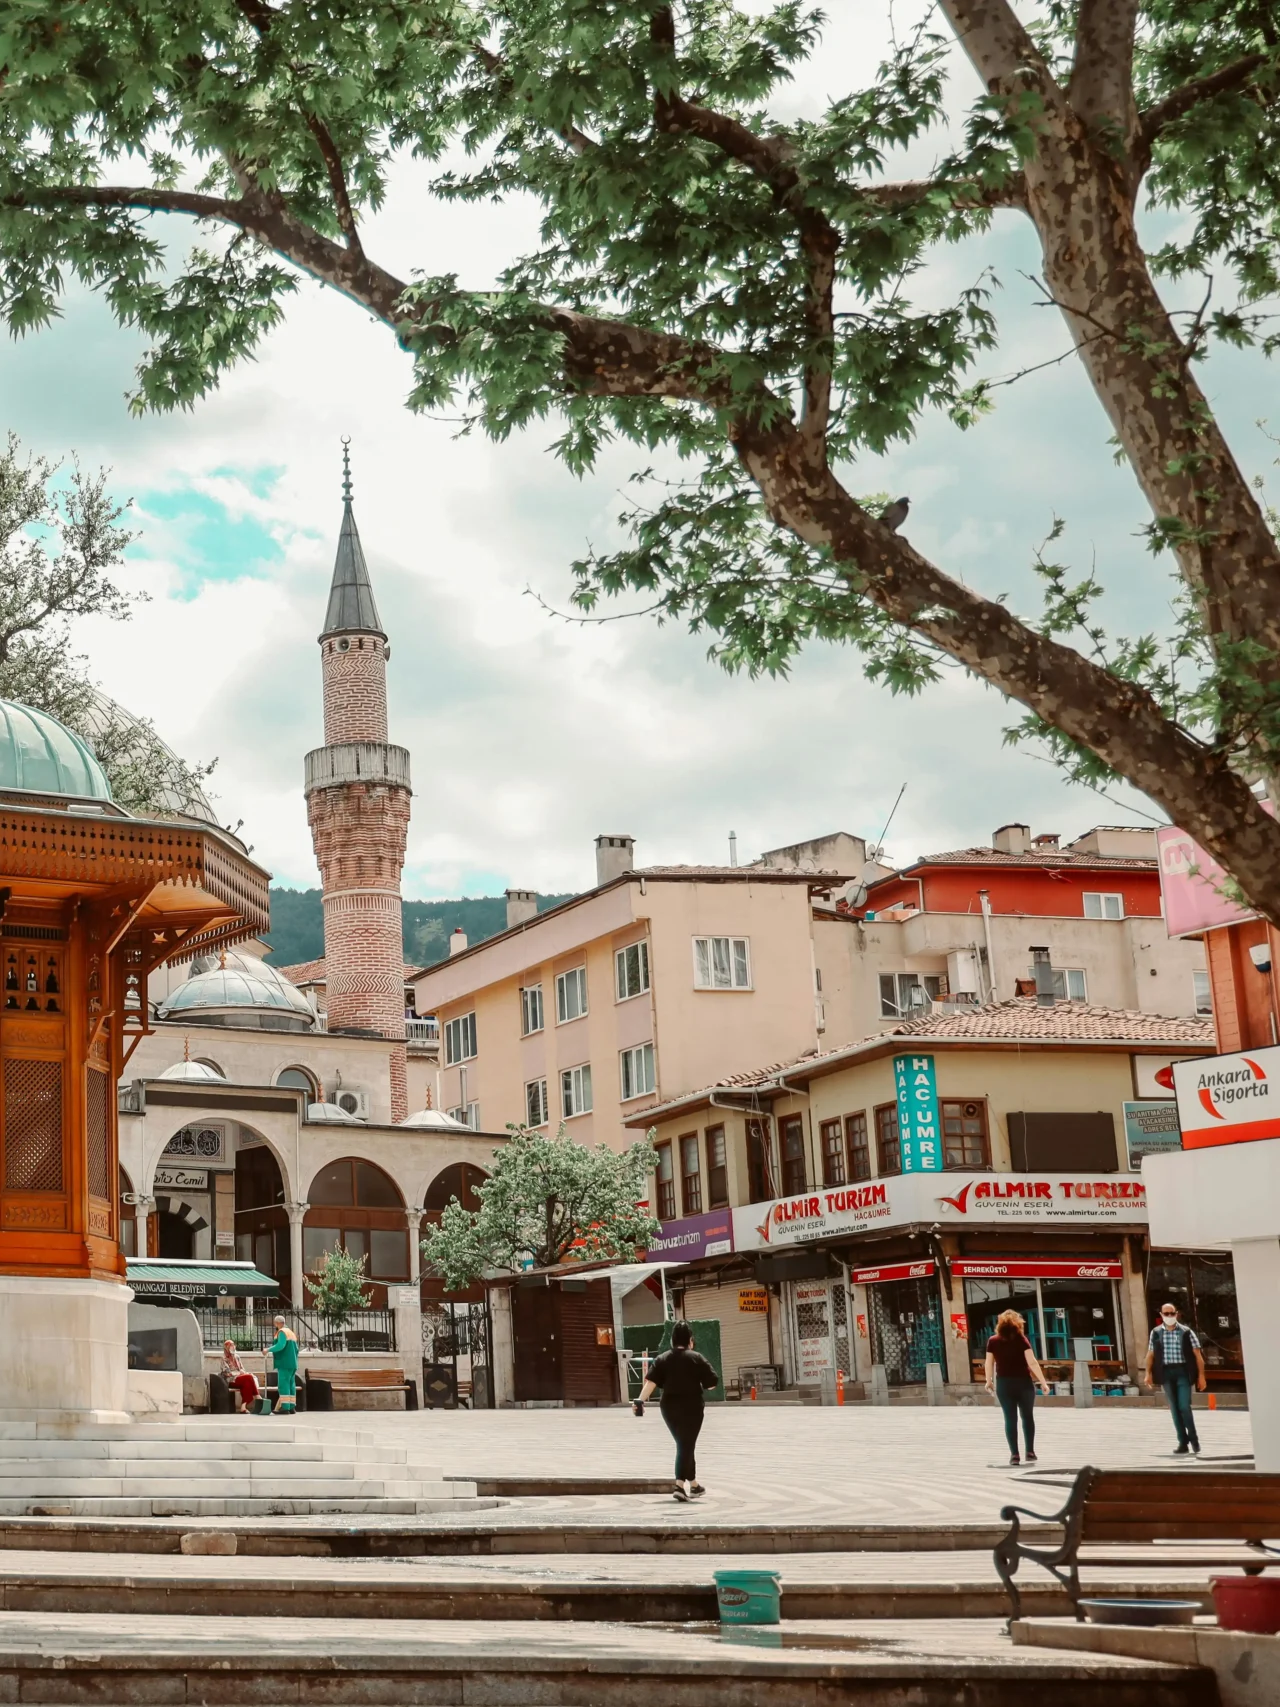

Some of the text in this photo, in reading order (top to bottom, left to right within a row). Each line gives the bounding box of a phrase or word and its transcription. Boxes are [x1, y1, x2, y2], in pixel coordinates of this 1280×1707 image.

[912, 1058, 931, 1101] HAC
[1197, 1069, 1251, 1089] Ankara
[1213, 1083, 1269, 1104] Sigorta
[917, 1111, 935, 1169] UMRE
[854, 1207, 891, 1221] HAC&UMRE
[1077, 1265, 1110, 1277] Coca-Cola
[169, 1283, 206, 1294] BELEDİYESİ
